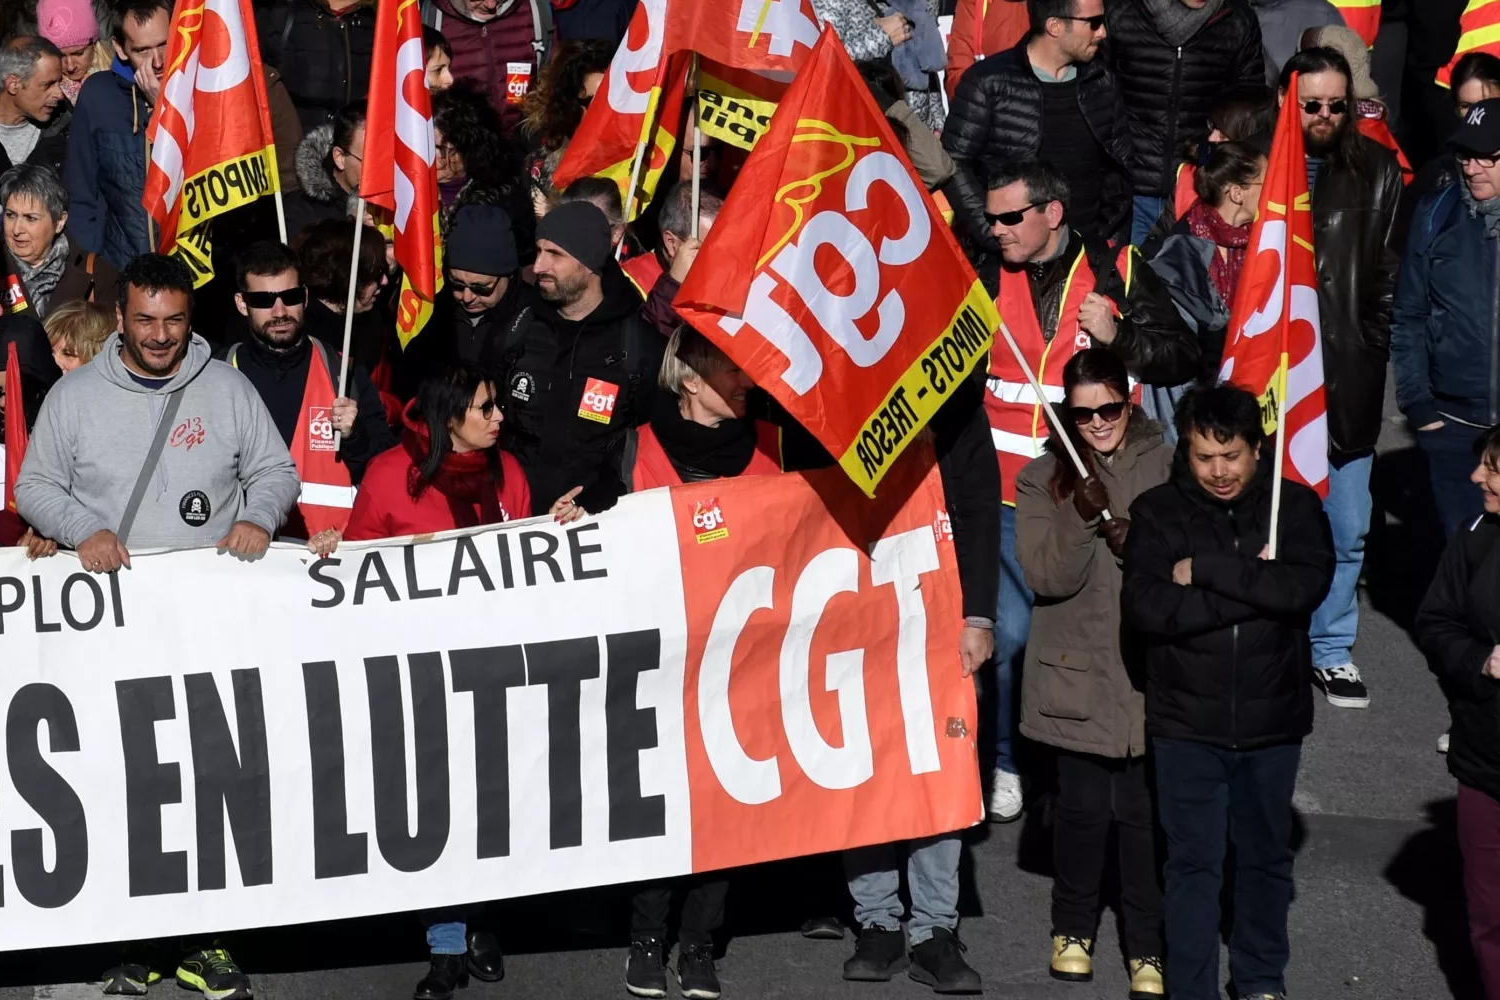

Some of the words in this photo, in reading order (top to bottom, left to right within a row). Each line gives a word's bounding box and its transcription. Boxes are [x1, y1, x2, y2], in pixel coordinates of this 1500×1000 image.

[508, 80, 529, 97] cgt
[583, 391, 615, 412] cgt
[185, 416, 203, 433] 13
[310, 421, 334, 439] cg
[693, 506, 724, 530] cgt
[311, 523, 607, 609] SALAIRE
[114, 668, 272, 898] EN
[302, 630, 666, 877] LUTTE
[700, 526, 941, 806] CGT
